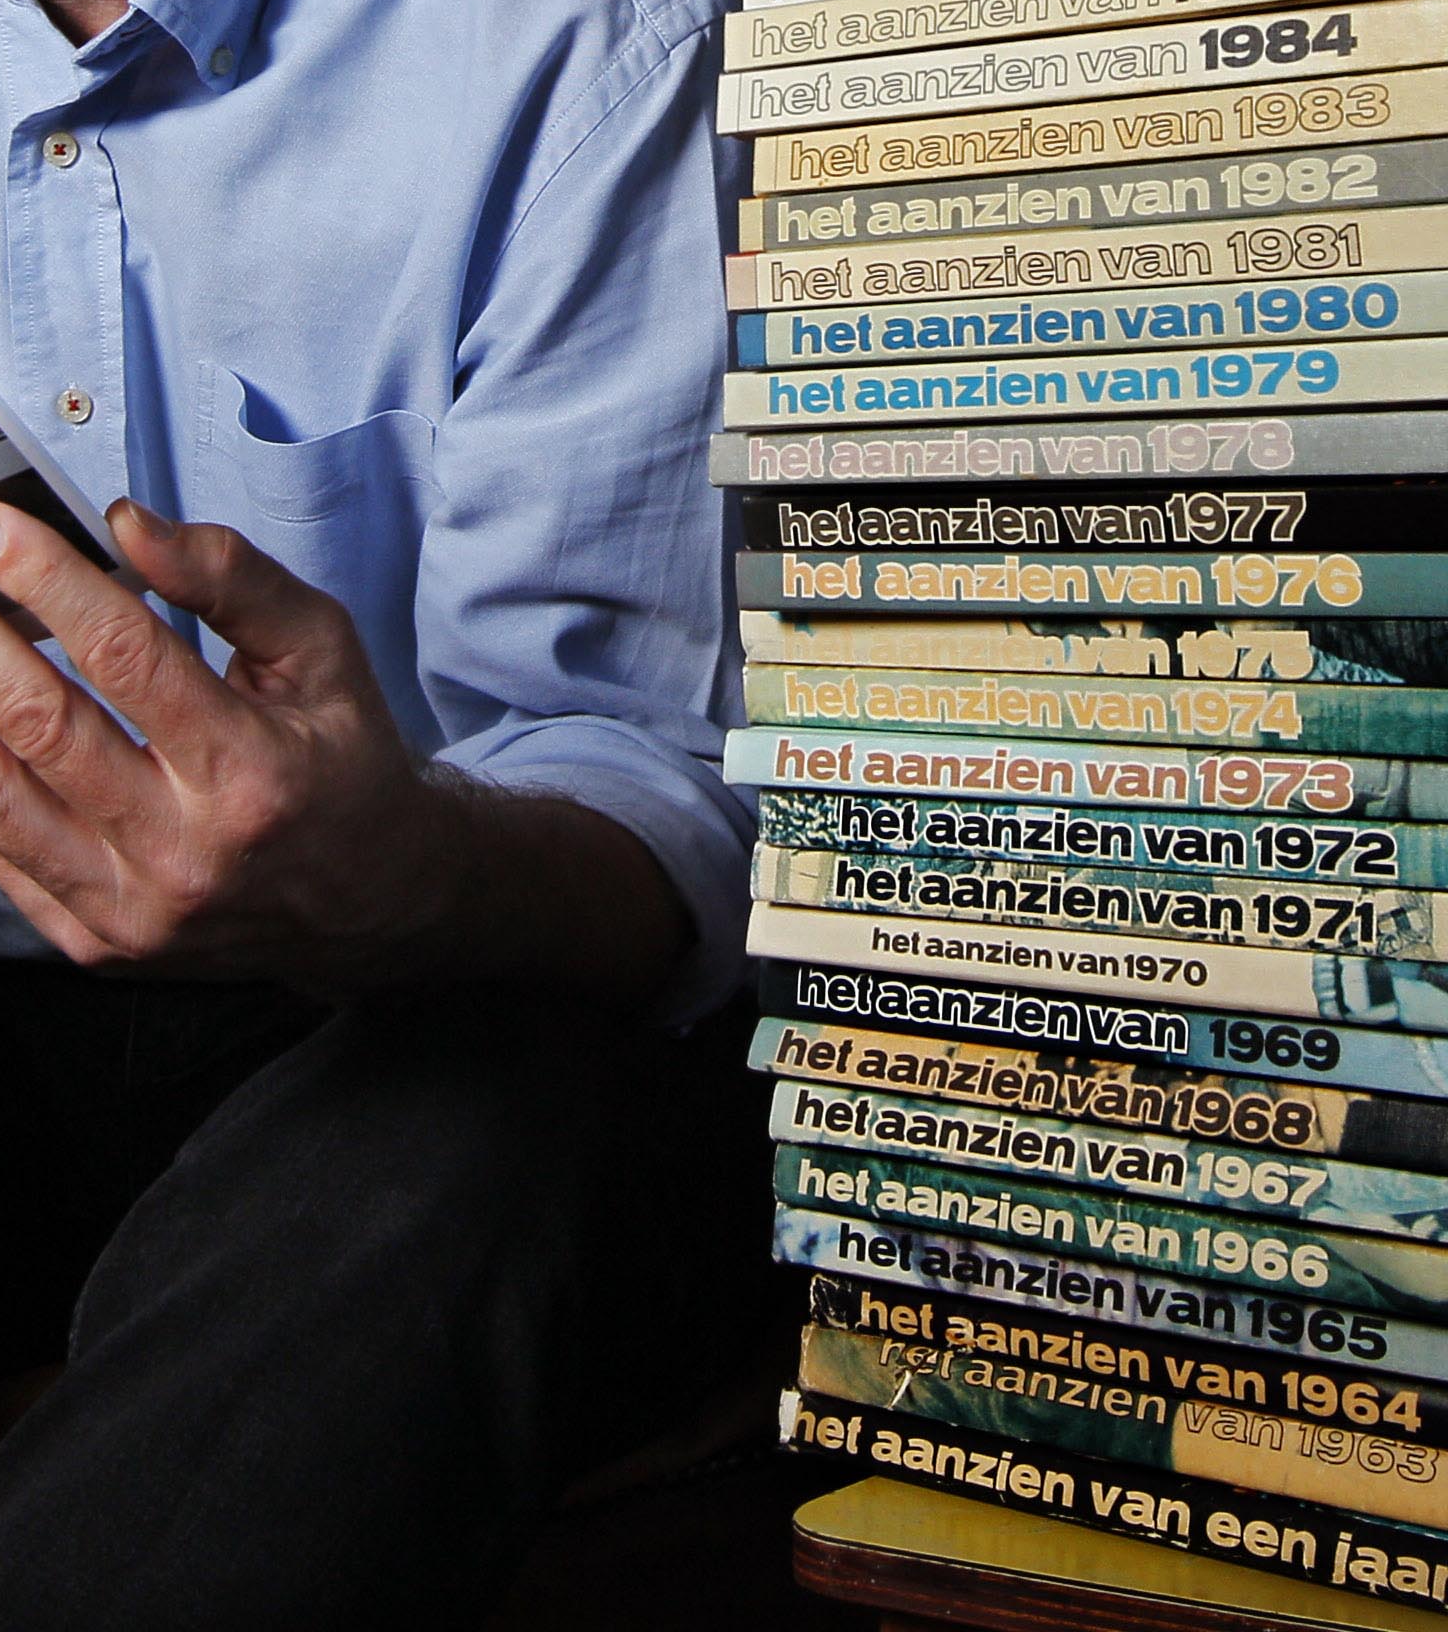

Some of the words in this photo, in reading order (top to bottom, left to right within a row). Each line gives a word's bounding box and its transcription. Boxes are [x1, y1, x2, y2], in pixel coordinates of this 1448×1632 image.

[750, 72, 832, 119] het
[840, 41, 1068, 110] aanzien
[1076, 37, 1187, 87] van
[1198, 13, 1358, 72] 1984
[791, 310, 873, 356] het
[880, 302, 1106, 353] aanzien
[1120, 295, 1226, 341] van
[1234, 282, 1401, 334] 1980
[778, 503, 853, 547] het
[854, 499, 1060, 546] aanzien
[1060, 504, 1164, 545] van
[1165, 491, 1306, 544] 1977
[837, 799, 917, 844] het
[924, 808, 1133, 861] aanzien
[1141, 821, 1247, 868] van
[1253, 822, 1398, 878] 1972
[871, 926, 923, 957] het
[924, 932, 1053, 971] aanzien
[1058, 946, 1122, 978] van
[1123, 953, 1209, 988] 1970
[797, 1158, 872, 1209] het
[875, 1175, 1077, 1242] aanzien
[1085, 1208, 1184, 1262] van
[1191, 1226, 1329, 1291] 1966
[871, 1429, 1075, 1507] aanzien
[1090, 1481, 1192, 1546] van
[1205, 1507, 1315, 1569] een
